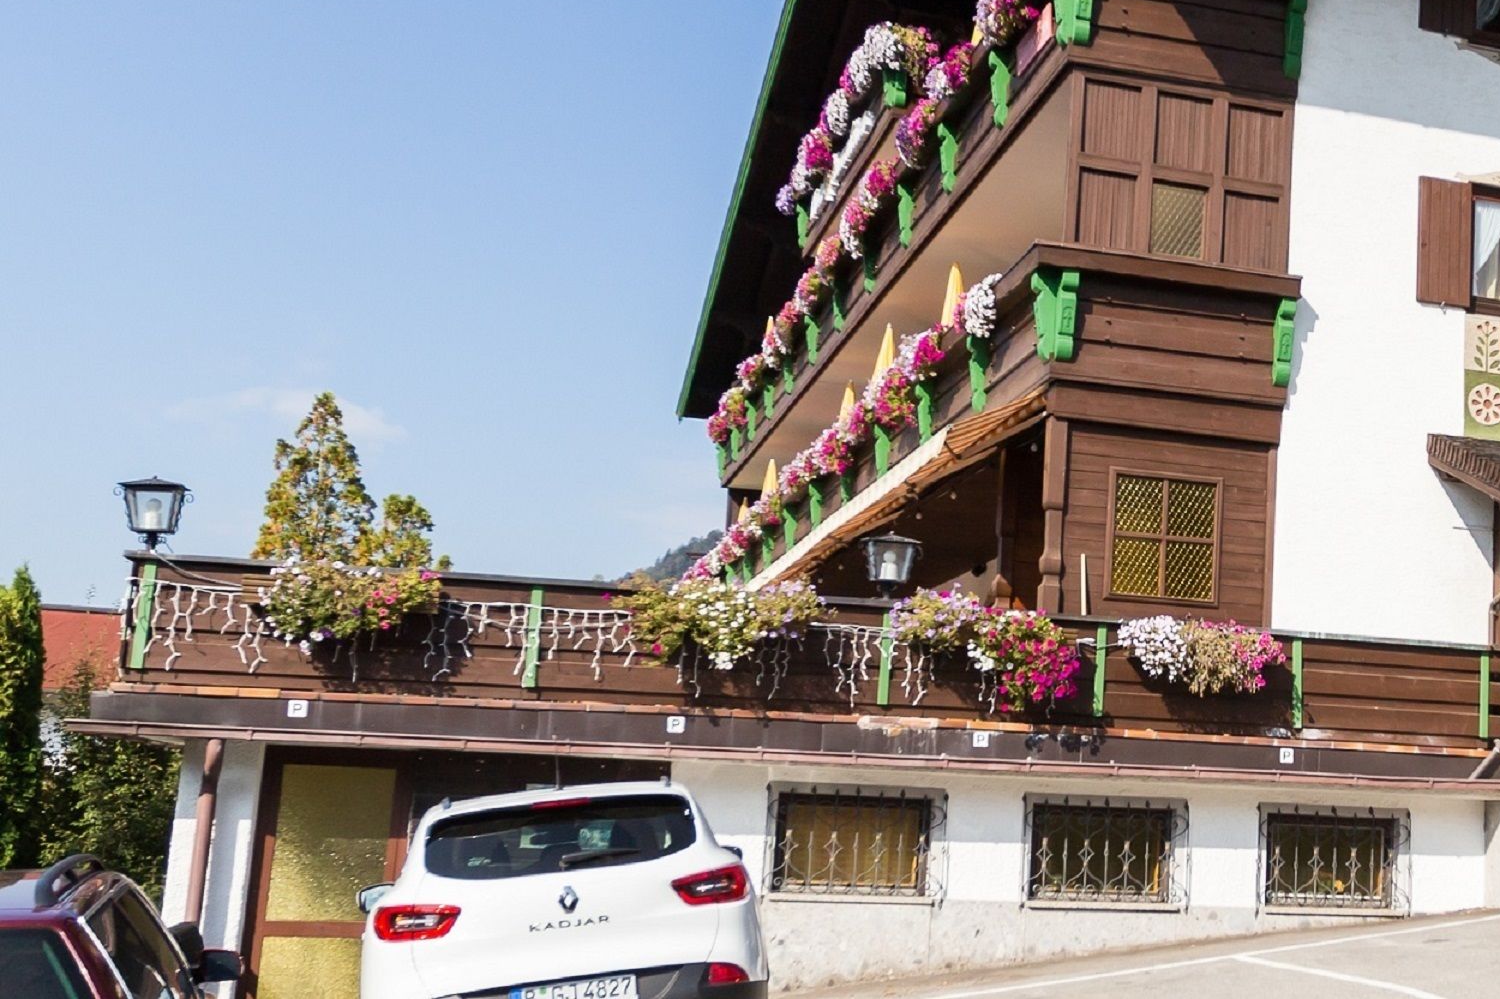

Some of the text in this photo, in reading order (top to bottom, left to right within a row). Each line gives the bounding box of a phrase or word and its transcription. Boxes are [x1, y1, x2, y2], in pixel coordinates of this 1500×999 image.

[293, 703, 302, 714] P
[672, 718, 680, 729] P
[977, 734, 984, 743] P
[1283, 751, 1291, 760] P
[529, 915, 609, 932] KADJAR
[583, 977, 631, 998] 4827
